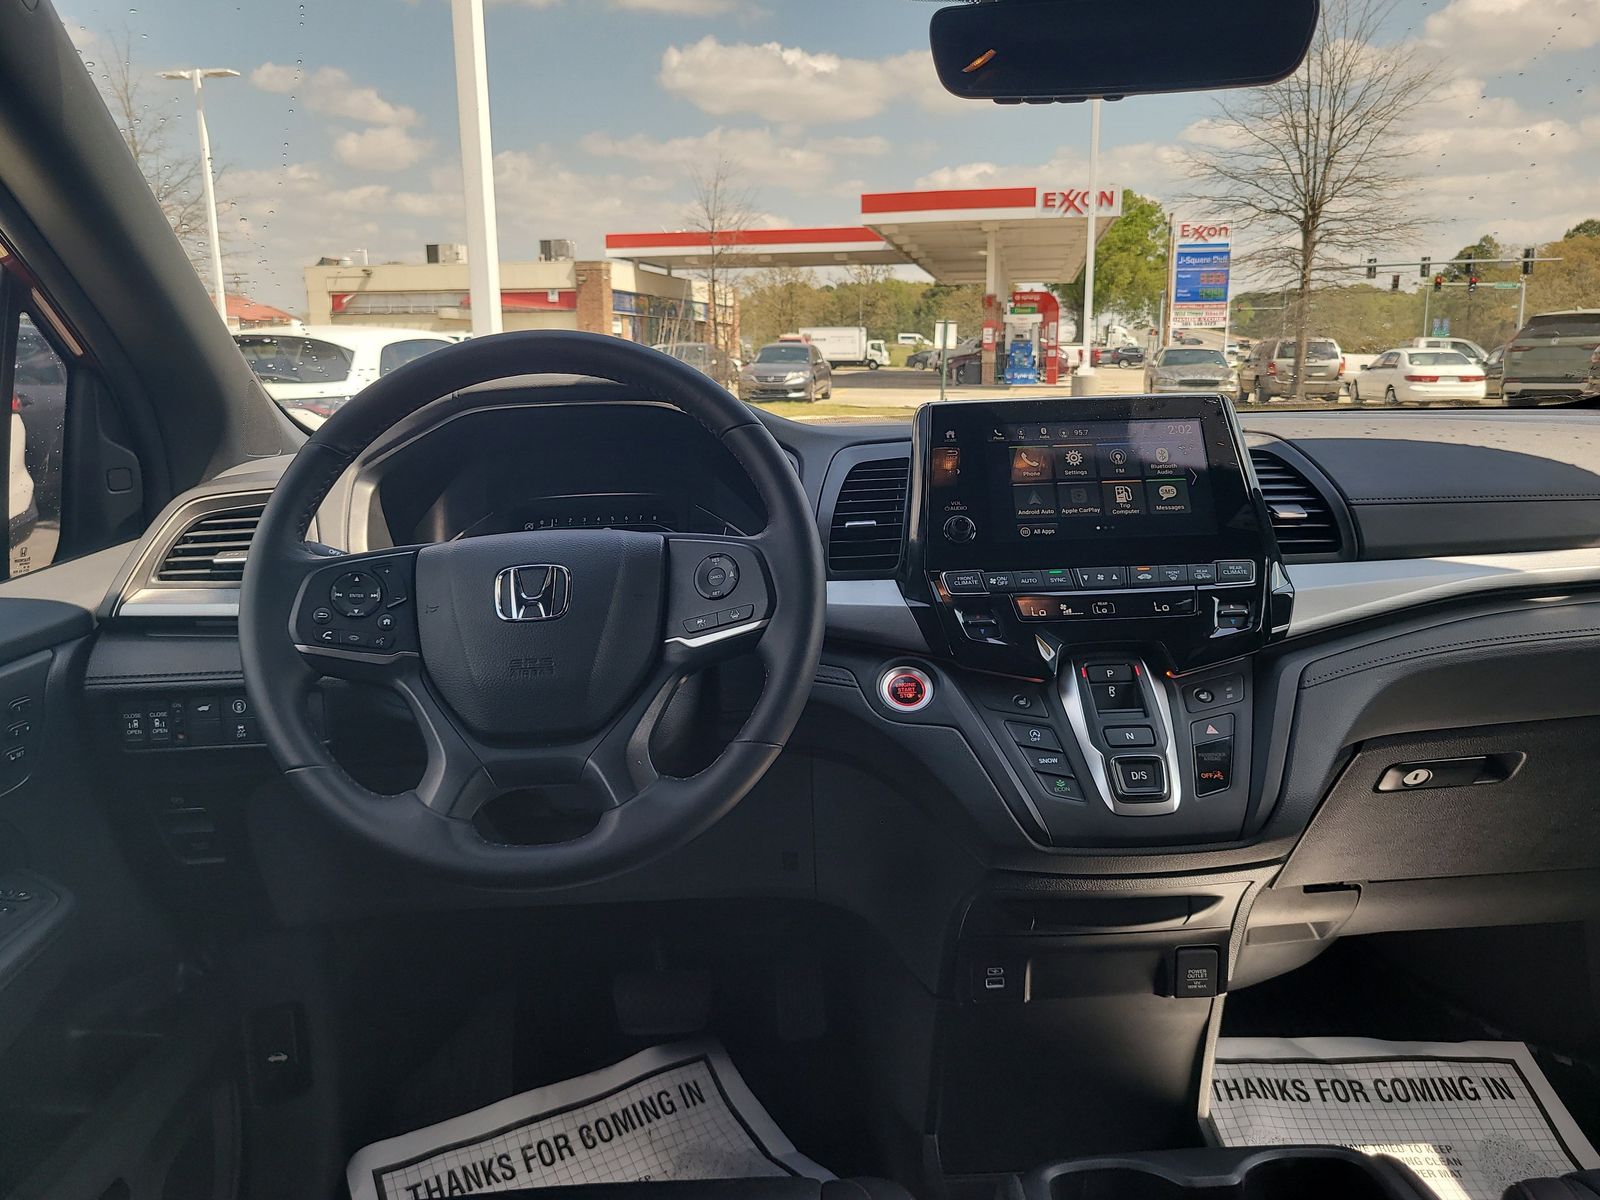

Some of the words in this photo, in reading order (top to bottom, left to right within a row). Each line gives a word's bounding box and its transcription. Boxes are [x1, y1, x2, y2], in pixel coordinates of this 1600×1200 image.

[1181, 224, 1229, 241] Exxon
[1168, 424, 1192, 434] 2:02
[1109, 686, 1115, 694] R
[1131, 771, 1147, 780] D/S
[1212, 1078, 1310, 1102] THANKS
[1313, 1078, 1370, 1103] FOR
[1372, 1076, 1482, 1103] COMING
[1480, 1077, 1516, 1100] IN
[404, 1153, 517, 1200] THANKS
[520, 1133, 576, 1174] FOR
[578, 1090, 677, 1150] COMING
[678, 1078, 706, 1109] IN
[1371, 1144, 1405, 1153] TRIED
[1408, 1144, 1422, 1153] TO
[1424, 1144, 1452, 1154] KEEP
[1425, 1157, 1462, 1166] CLEAN
[1438, 1170, 1462, 1178] MAT
